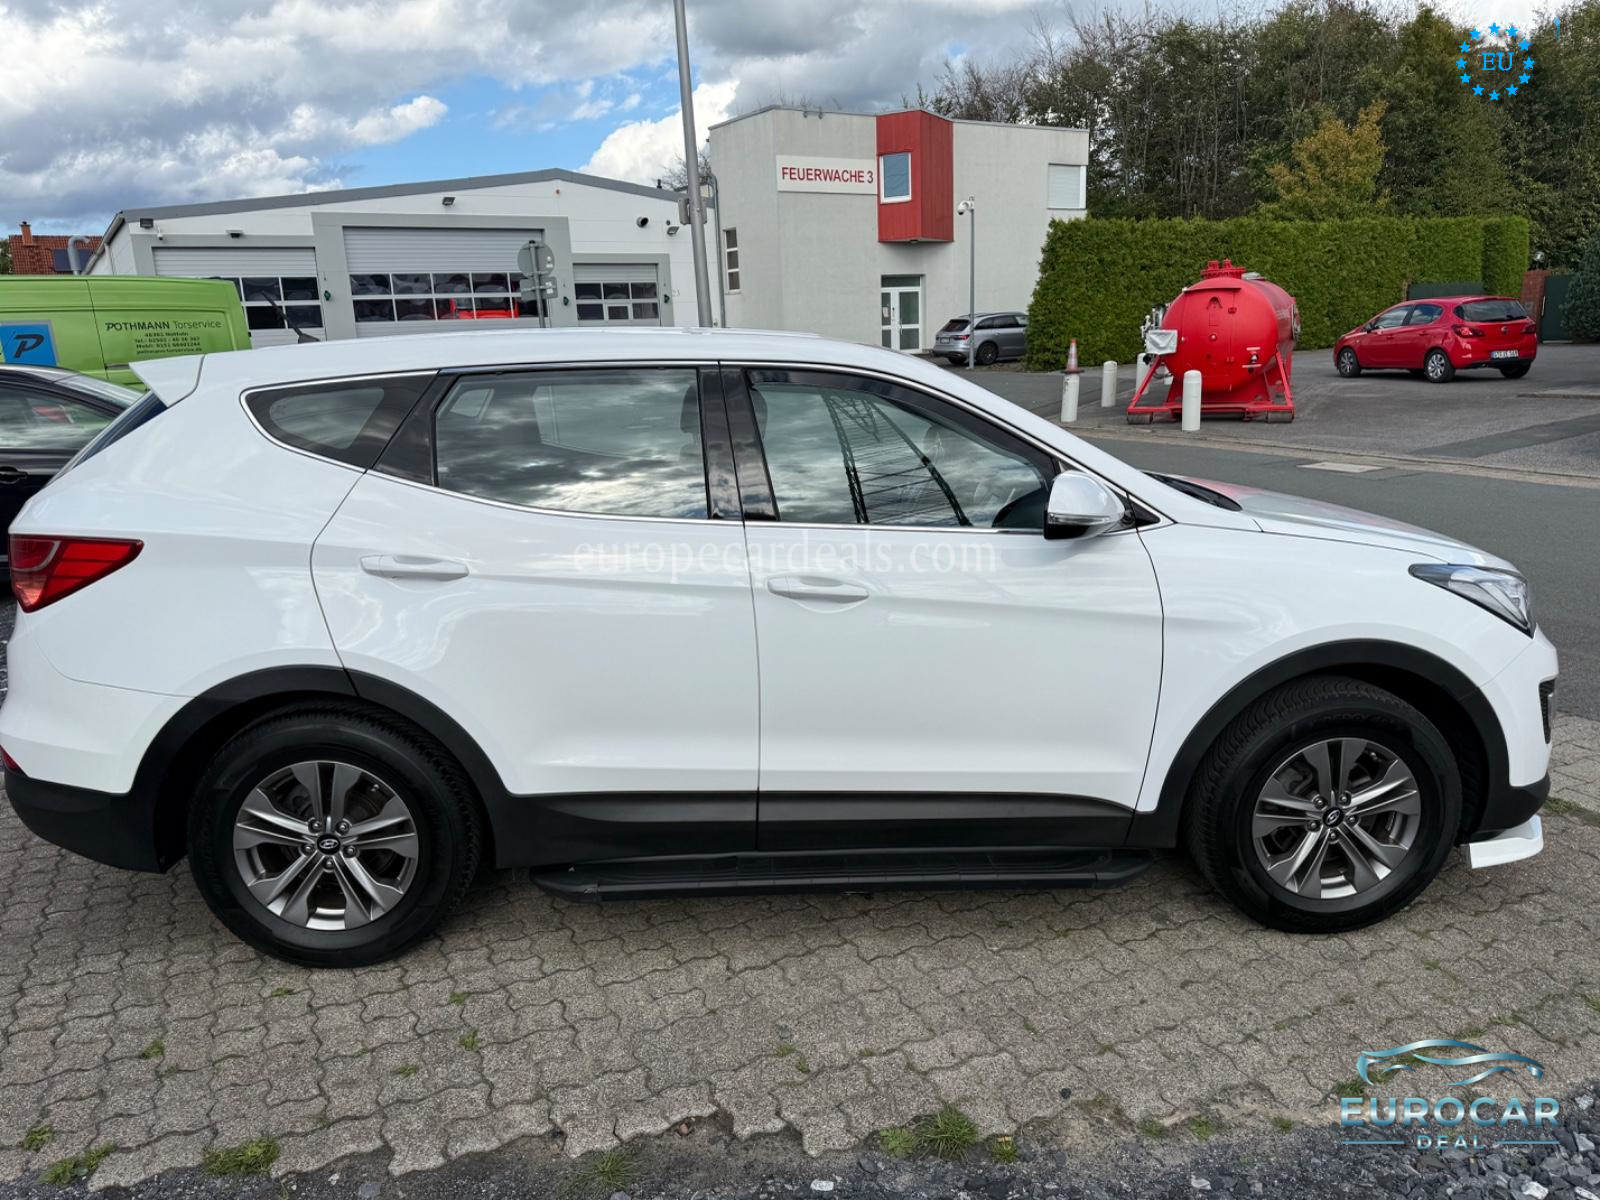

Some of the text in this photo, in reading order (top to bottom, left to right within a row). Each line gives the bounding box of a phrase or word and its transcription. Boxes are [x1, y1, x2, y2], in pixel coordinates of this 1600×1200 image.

[781, 167, 874, 184] FEUERWACHE 3
[105, 320, 222, 331] POTHMANN Torservice
